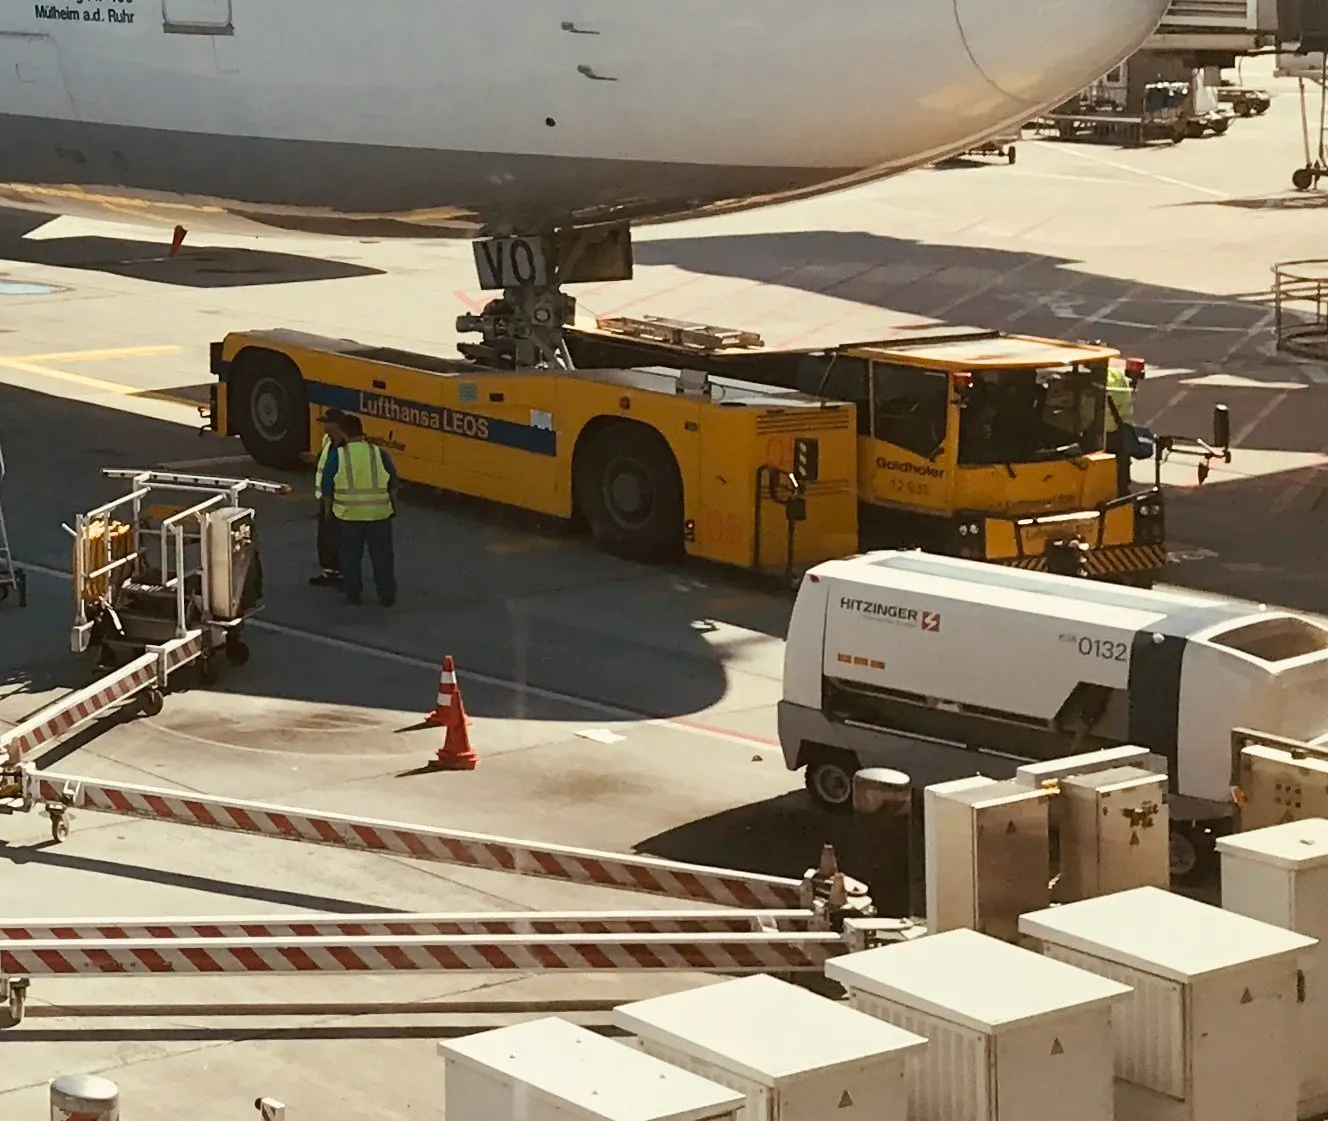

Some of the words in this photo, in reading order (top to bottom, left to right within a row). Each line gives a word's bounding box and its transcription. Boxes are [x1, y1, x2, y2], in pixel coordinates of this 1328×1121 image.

[35, 5, 80, 21] Mülheim
[83, 8, 105, 22] a.d.
[108, 8, 134, 23] Ruhr
[359, 392, 440, 428] Lufthansa
[443, 409, 489, 439] LEOS
[840, 597, 918, 621] HITZINGER
[1078, 636, 1128, 662] 0132
